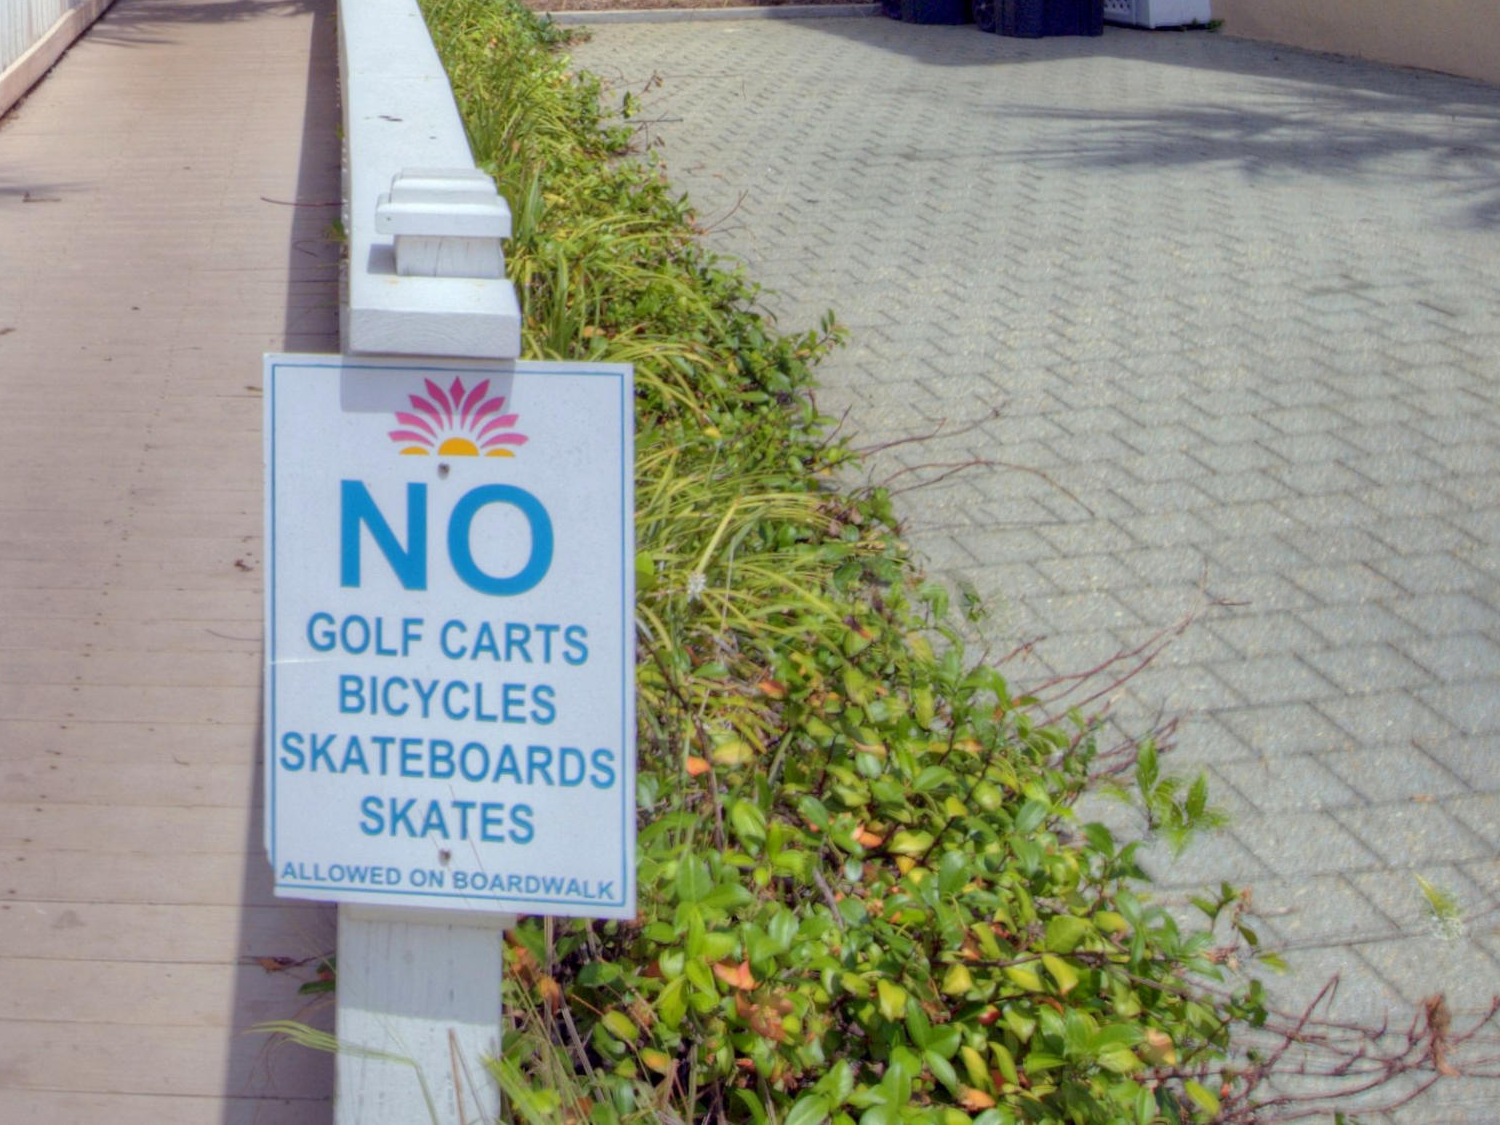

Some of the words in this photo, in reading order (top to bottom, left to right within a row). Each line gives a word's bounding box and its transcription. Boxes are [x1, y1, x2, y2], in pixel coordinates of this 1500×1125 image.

[341, 479, 554, 596] NO
[307, 612, 424, 657] GOLF
[440, 620, 589, 665] CARTS
[339, 675, 556, 724] BICYCLES
[280, 731, 616, 788] SKATEBOARDS
[359, 796, 535, 844] SKATES
[281, 861, 400, 886] ALLOWED
[409, 869, 445, 889] ON
[454, 870, 614, 901] BOARDWALK
